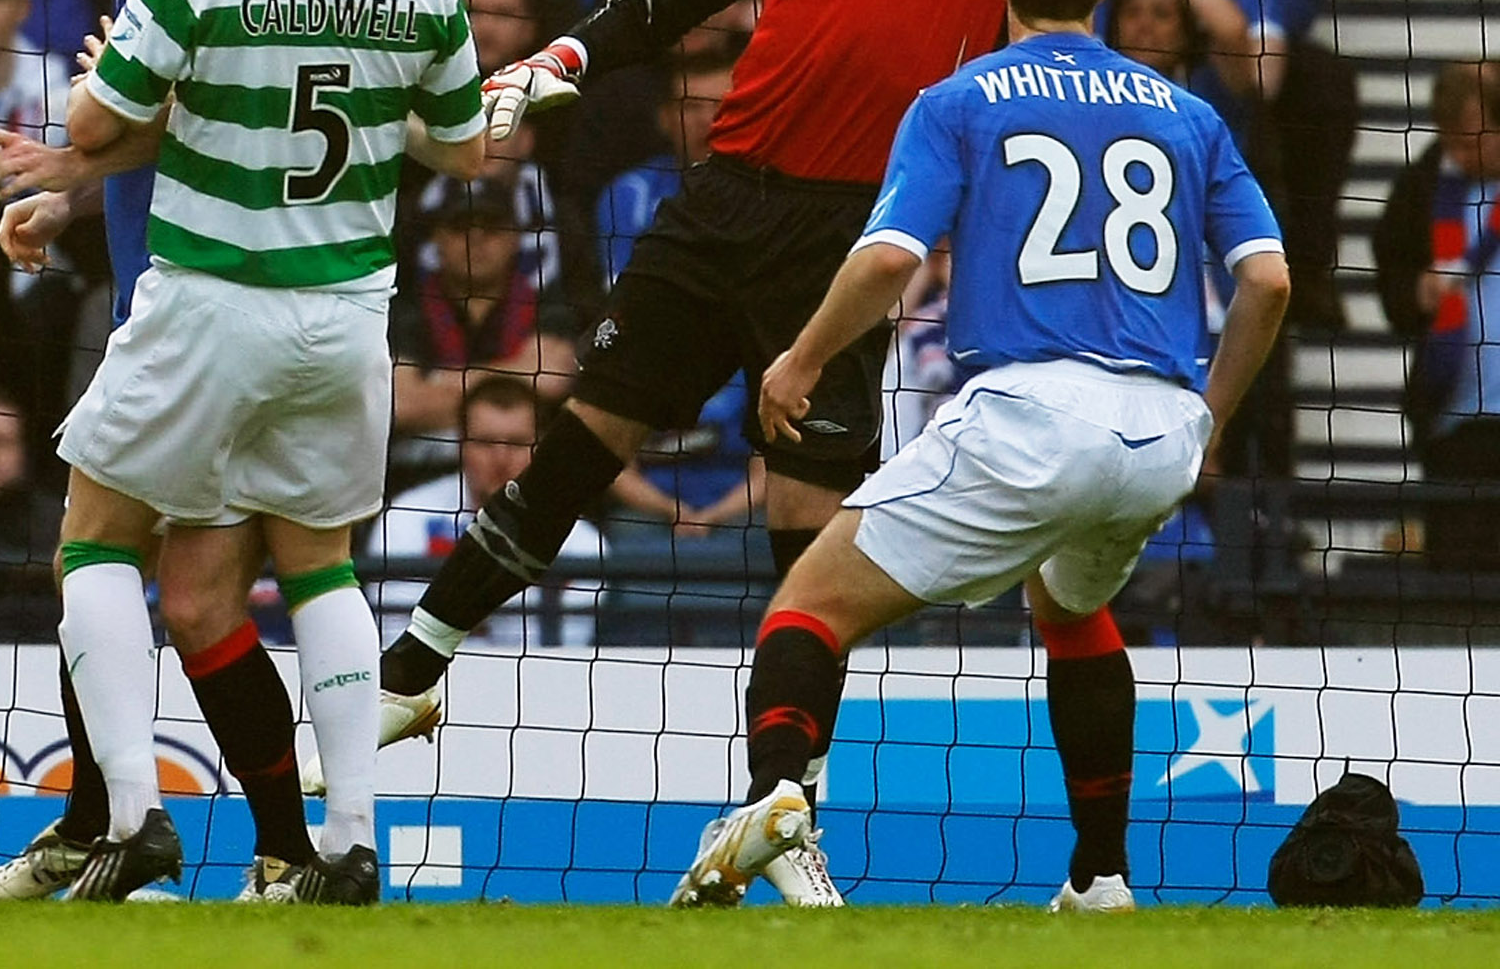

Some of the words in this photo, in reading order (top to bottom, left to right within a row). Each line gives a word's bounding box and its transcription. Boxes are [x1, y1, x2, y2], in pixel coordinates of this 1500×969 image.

[283, 62, 353, 205] 5
[974, 63, 1178, 114] WHITTAKER
[1003, 133, 1178, 295] 28
[313, 670, 371, 693] celtic
